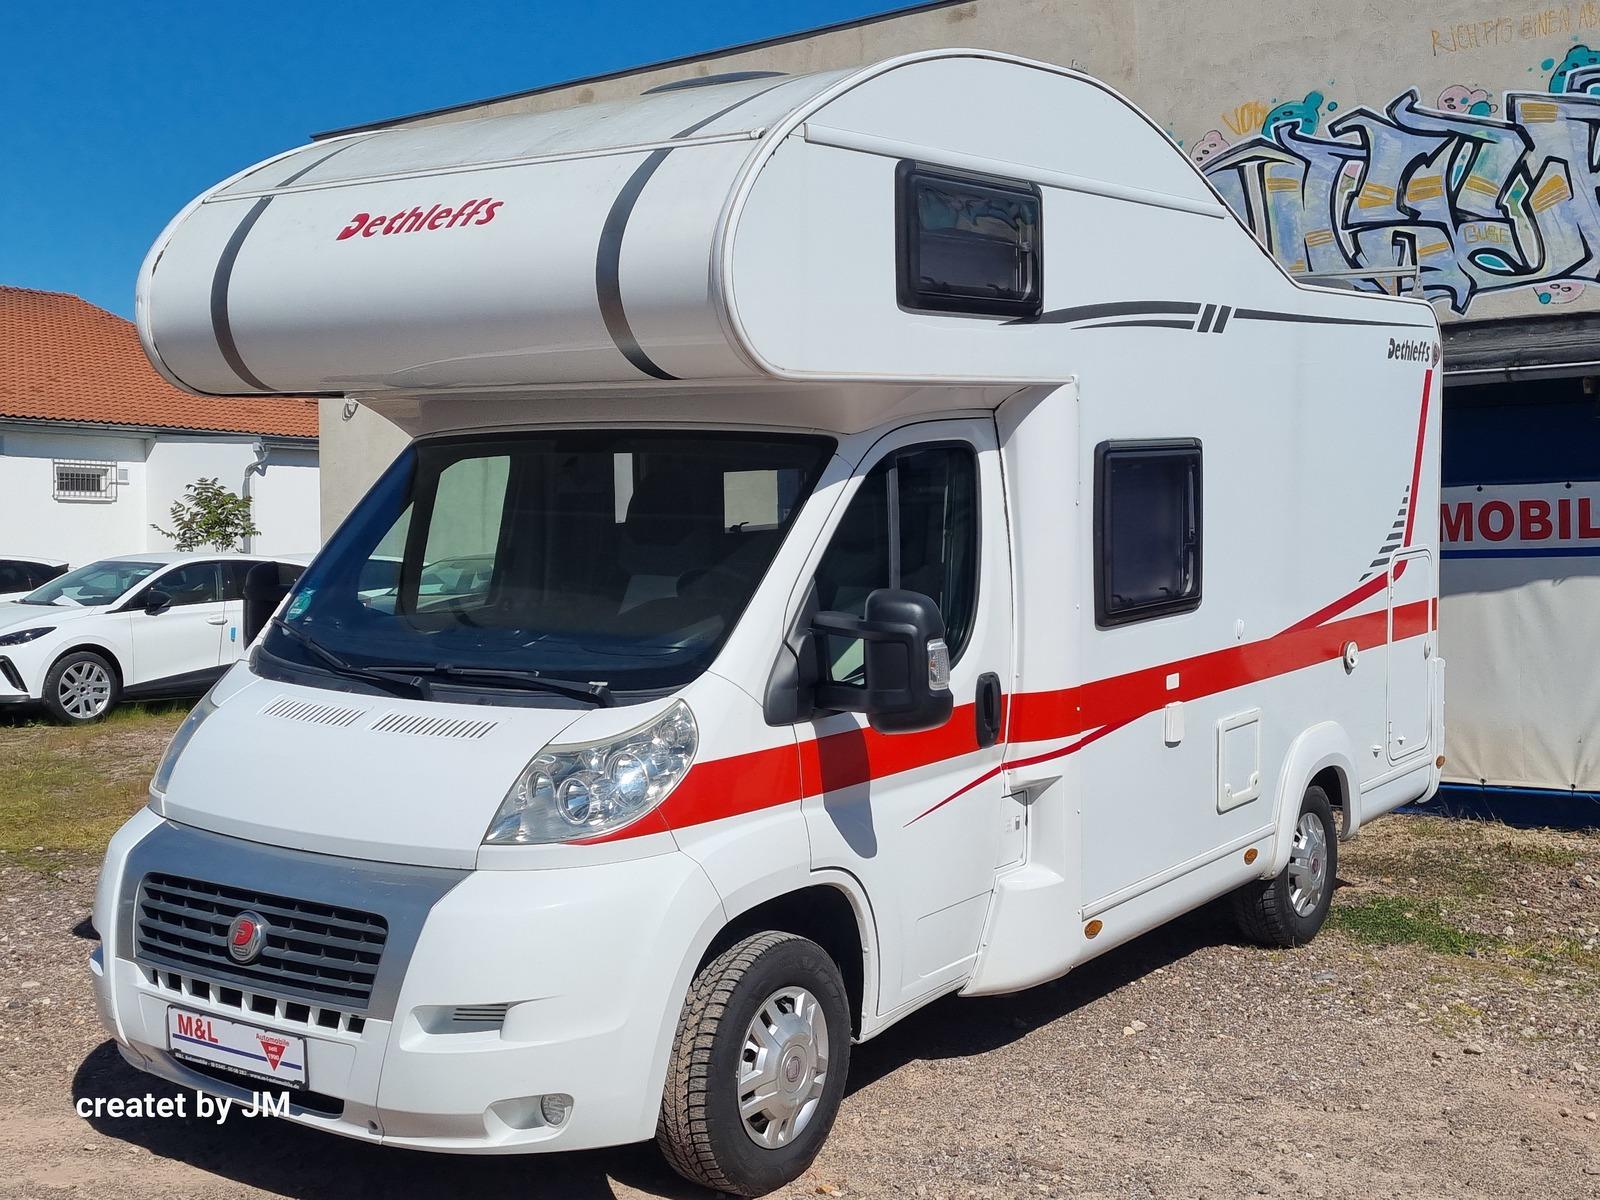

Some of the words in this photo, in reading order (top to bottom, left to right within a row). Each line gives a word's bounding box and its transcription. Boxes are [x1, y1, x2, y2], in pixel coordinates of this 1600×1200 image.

[336, 198, 504, 240] Dethleffs
[1388, 338, 1430, 362] Dethleffs
[178, 1014, 218, 1043] M&L
[256, 1033, 289, 1046] Automobile
